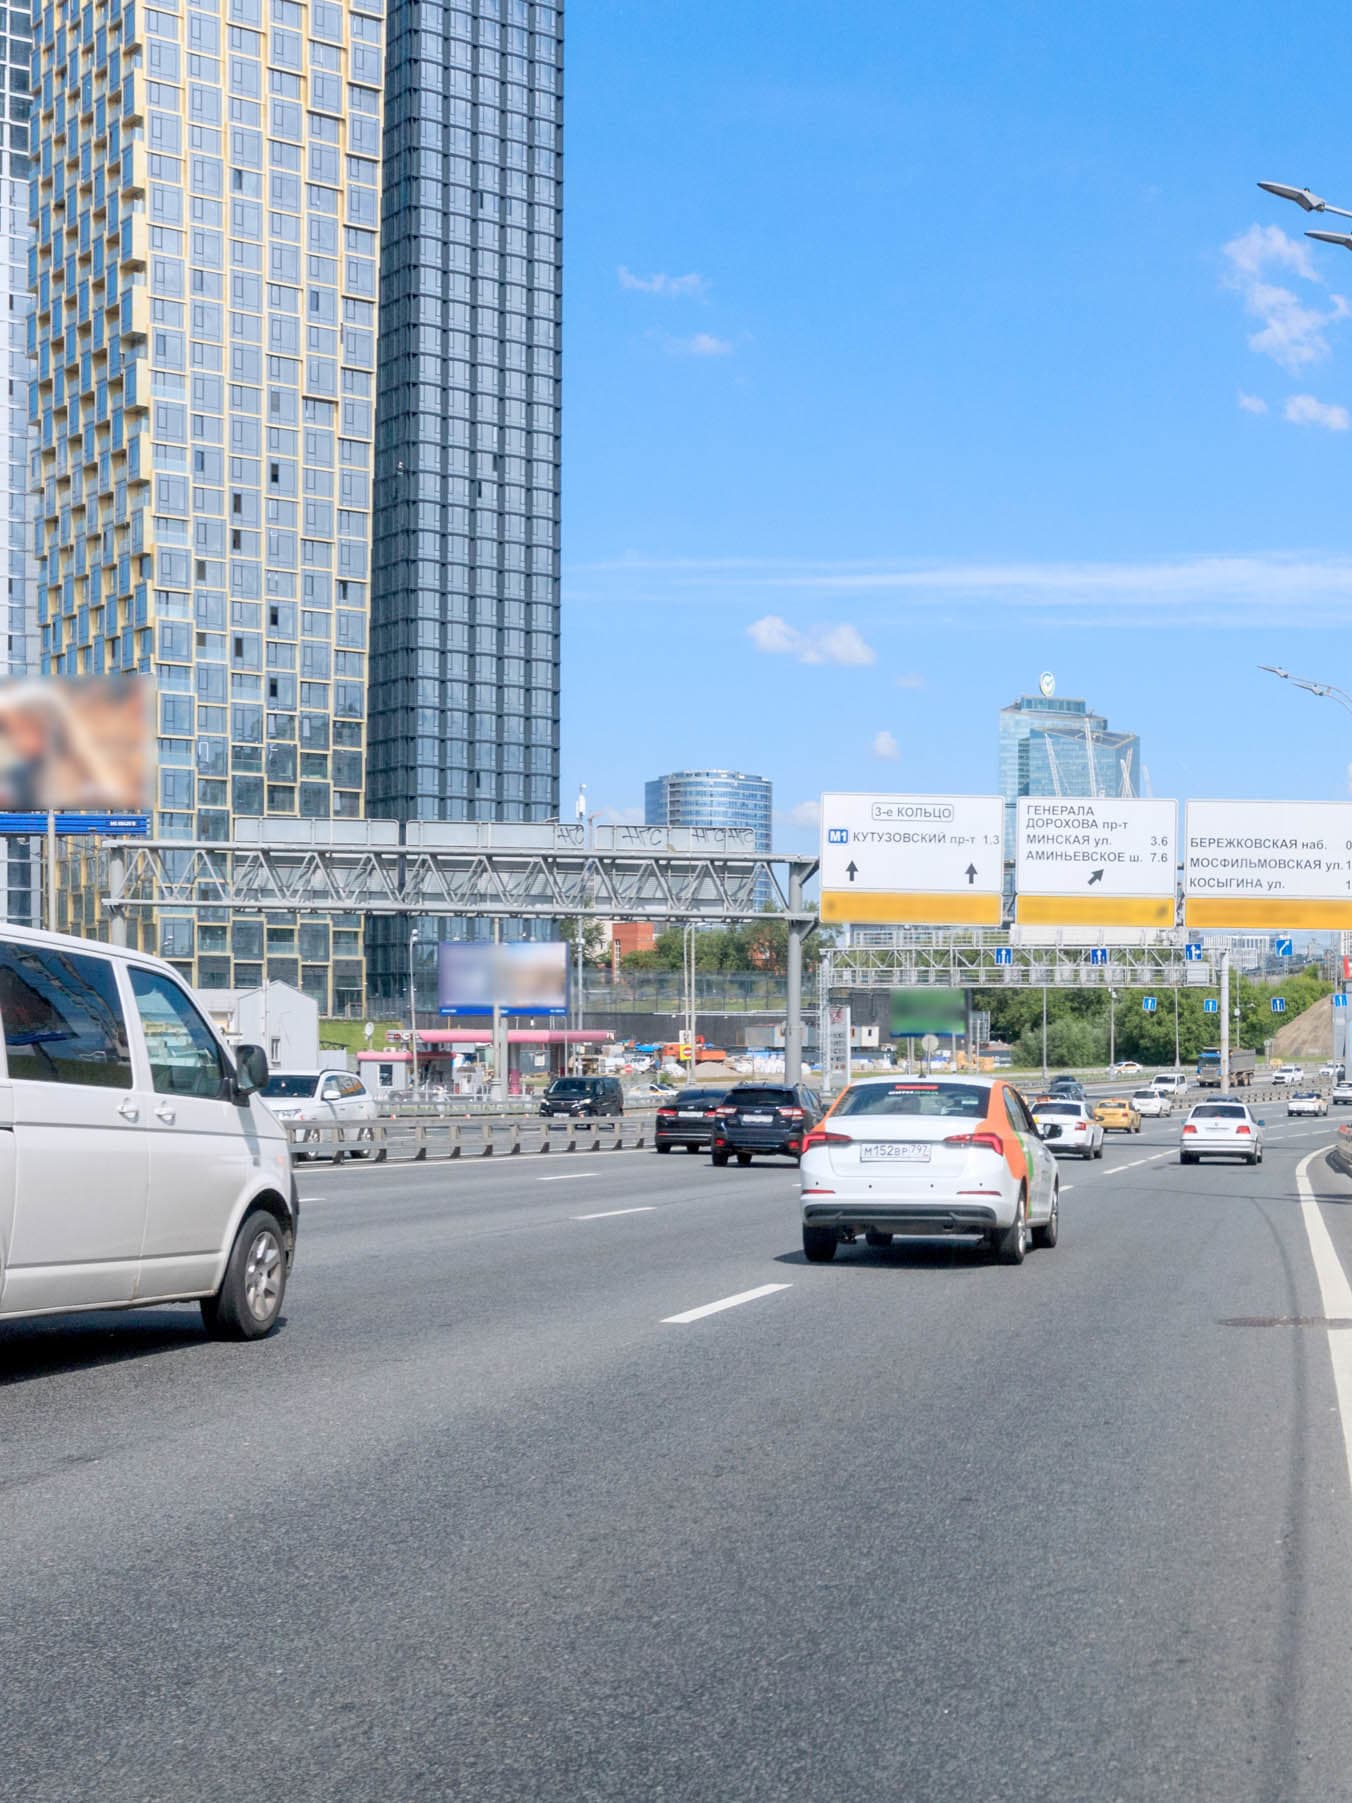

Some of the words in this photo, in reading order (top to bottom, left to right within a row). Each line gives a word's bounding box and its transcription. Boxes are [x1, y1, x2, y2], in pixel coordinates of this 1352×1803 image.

[874, 807, 893, 817] 3-е
[897, 807, 952, 819] КОЛЬЦО
[1026, 805, 1095, 816] ГЕНЕРАЛА
[1026, 818, 1099, 830] ДОРОХОВА
[1102, 822, 1128, 831] пр-т
[830, 831, 847, 842] М1
[853, 831, 946, 844] КУТУЗОВСКИЙ
[950, 836, 976, 846] пр-т
[983, 835, 1000, 845] 1.3
[1026, 834, 1090, 845] МИНСКАЯ
[1093, 837, 1112, 847] ул.
[1150, 836, 1168, 847] 3.6
[1190, 837, 1298, 849] БЕРЕЖКОВСКАЯ
[1301, 839, 1327, 850] наб.
[1026, 850, 1126, 863] АМИНЬЕВСКОЕ
[1129, 855, 1143, 863] ш.
[1150, 852, 1168, 863] 7.6
[1190, 857, 1322, 870] МОСФИЛЬМОВСКАЯ
[1325, 861, 1343, 872] ул.
[1189, 877, 1263, 889] КОСЫГИНА
[1266, 879, 1285, 891] ул.
